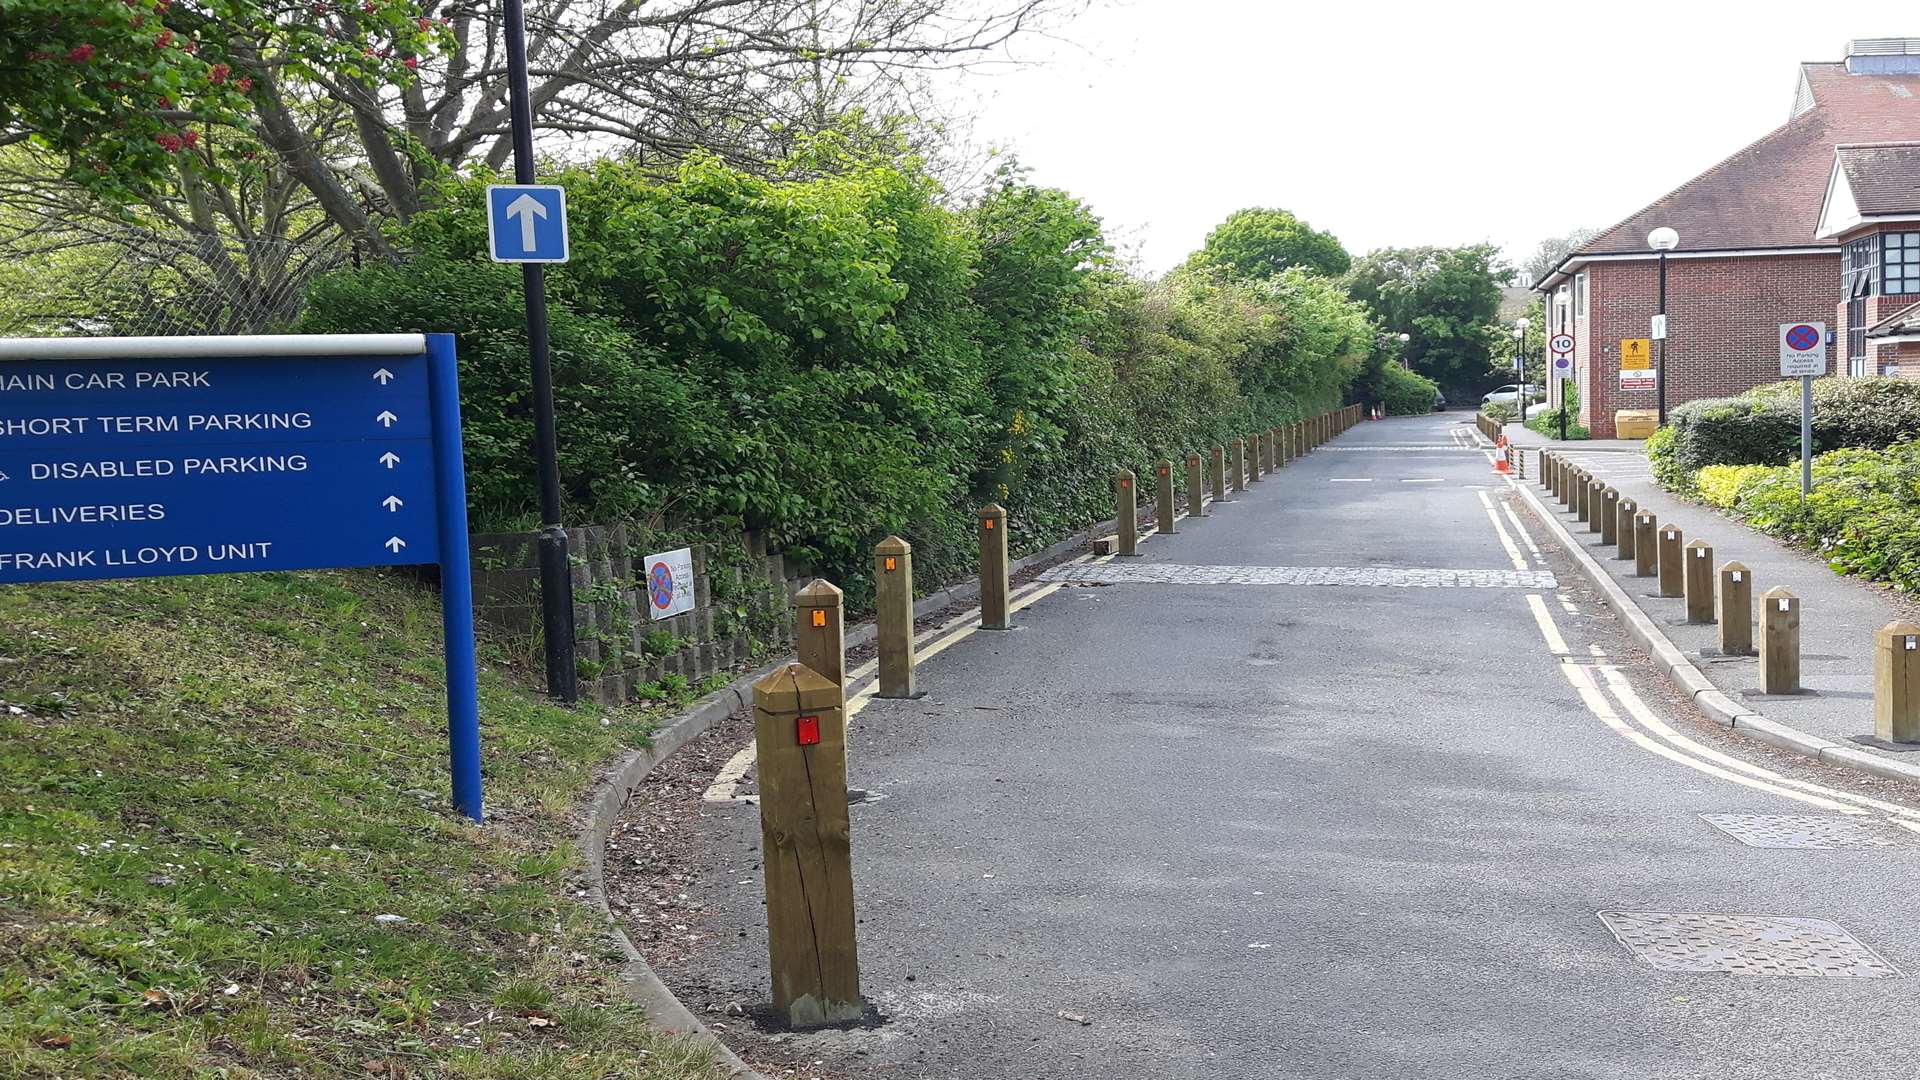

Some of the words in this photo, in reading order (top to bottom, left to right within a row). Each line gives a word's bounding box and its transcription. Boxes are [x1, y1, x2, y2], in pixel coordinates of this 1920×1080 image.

[1555, 339, 1571, 348] 10
[0, 374, 54, 390] AIN
[65, 373, 126, 390] CAR
[135, 371, 211, 388] PARK
[0, 418, 89, 436] HORT
[97, 415, 179, 433] TERM
[188, 412, 312, 431] PARKING
[31, 459, 174, 480] DISABLED
[184, 455, 307, 474] PARKING
[0, 504, 165, 525] DELIVERIES
[0, 550, 96, 570] FRANK
[106, 547, 198, 565] LLOYD
[208, 542, 272, 560] UNIT
